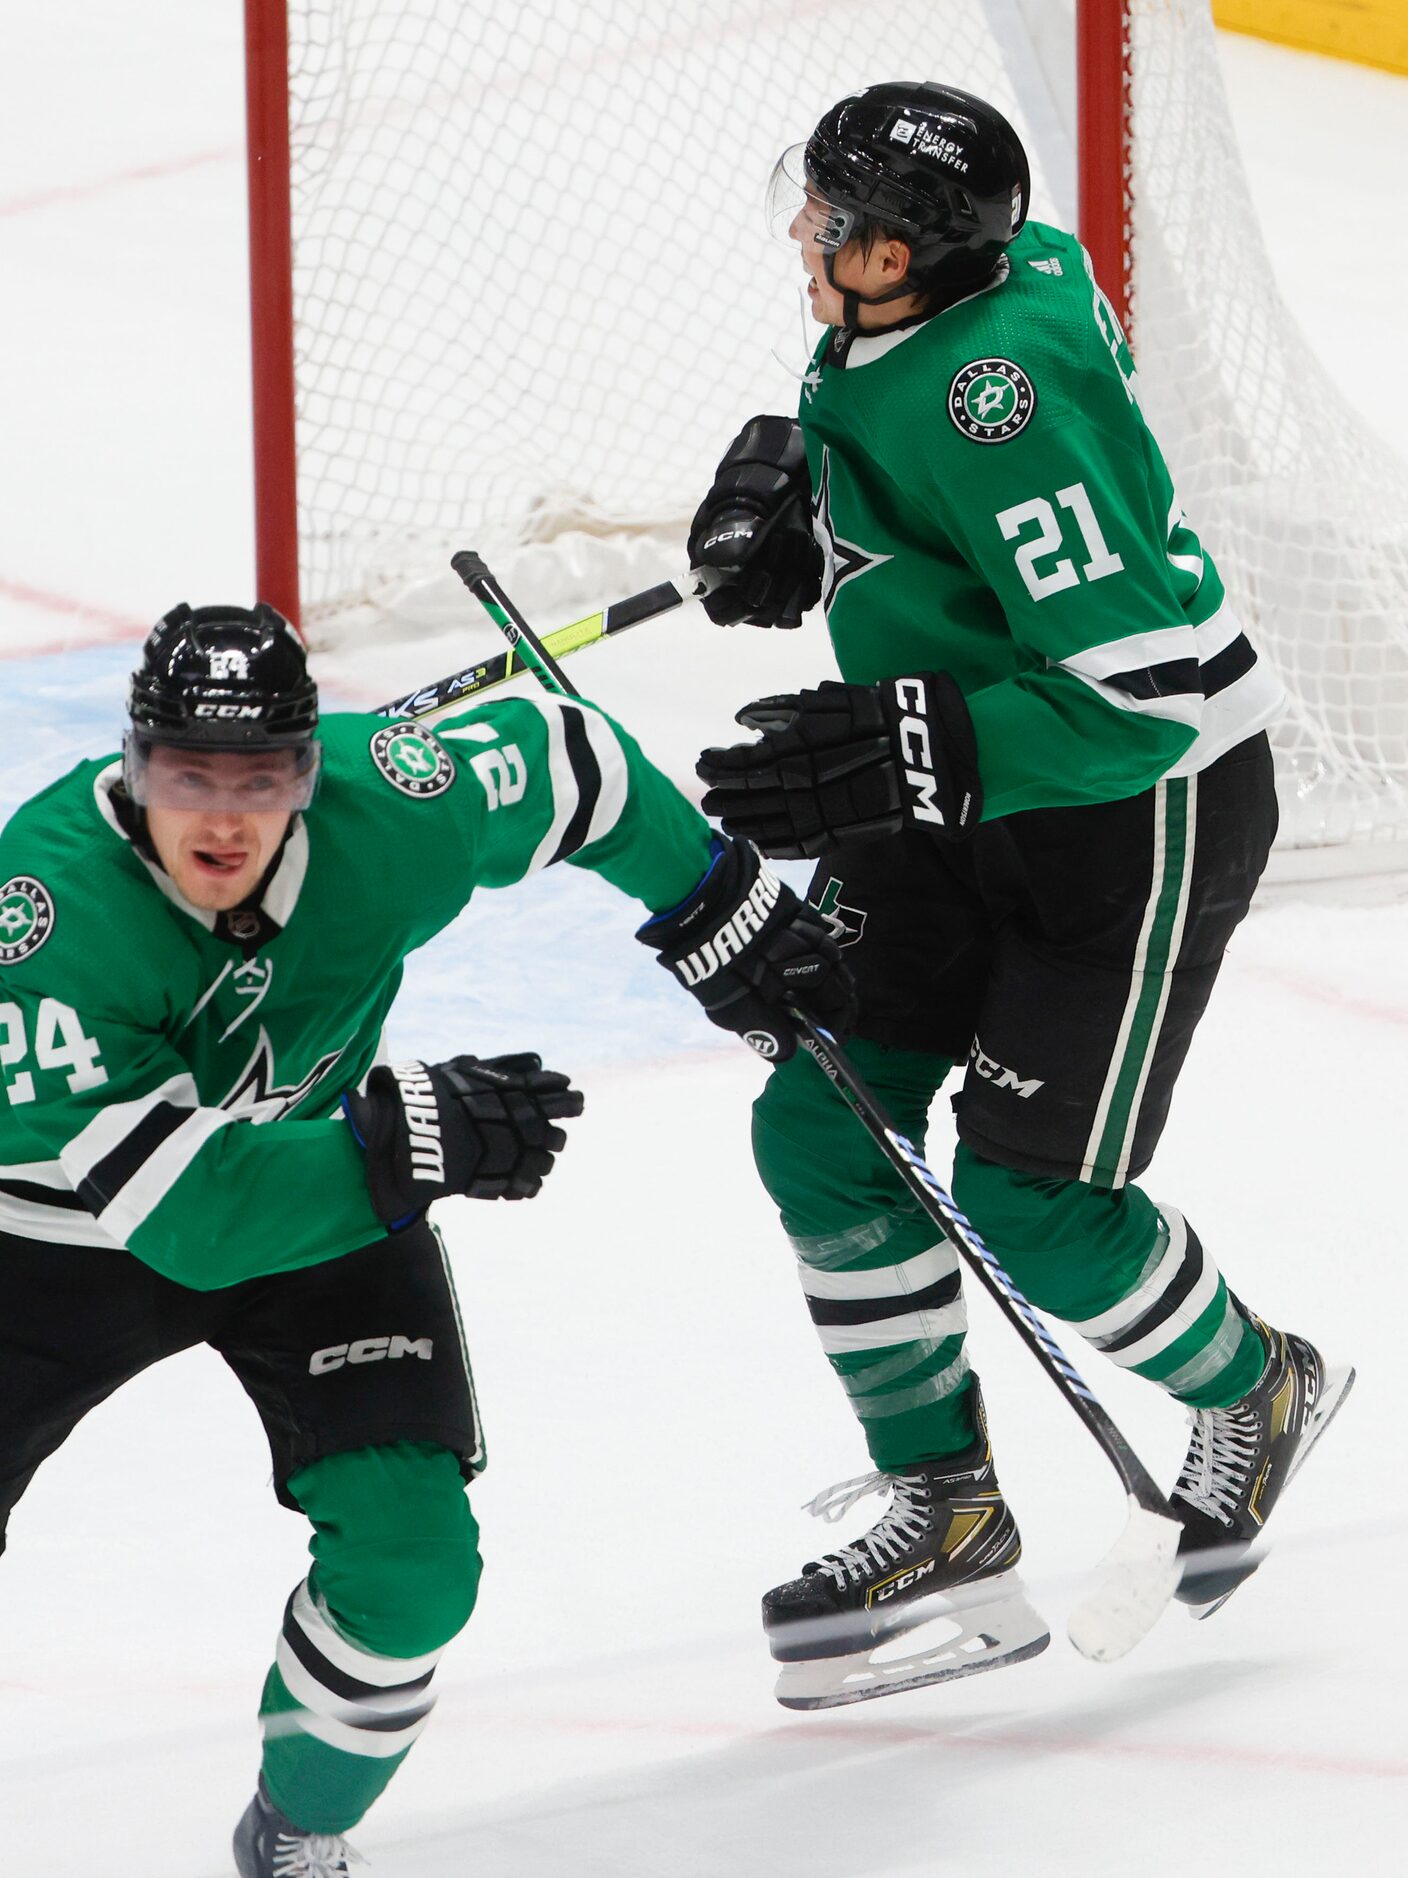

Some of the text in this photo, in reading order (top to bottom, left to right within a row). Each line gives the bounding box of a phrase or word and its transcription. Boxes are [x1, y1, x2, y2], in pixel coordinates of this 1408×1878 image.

[912, 138, 969, 173] TRANSFER
[916, 126, 964, 156] ENERGY
[954, 364, 1020, 408] DALLAS
[968, 399, 1028, 437] STARS
[703, 528, 753, 550] CCM
[996, 482, 1125, 602] 21
[448, 667, 486, 694] AS3
[463, 682, 480, 694] PRO
[194, 704, 263, 719] CCM
[378, 689, 439, 719] KS
[895, 678, 945, 826] CCM
[959, 792, 972, 827] ROBERTSON
[783, 964, 820, 977] COVERT
[805, 1039, 838, 1081] ALPHA
[309, 1336, 433, 1376] CCM
[877, 1560, 935, 1601] CCM
